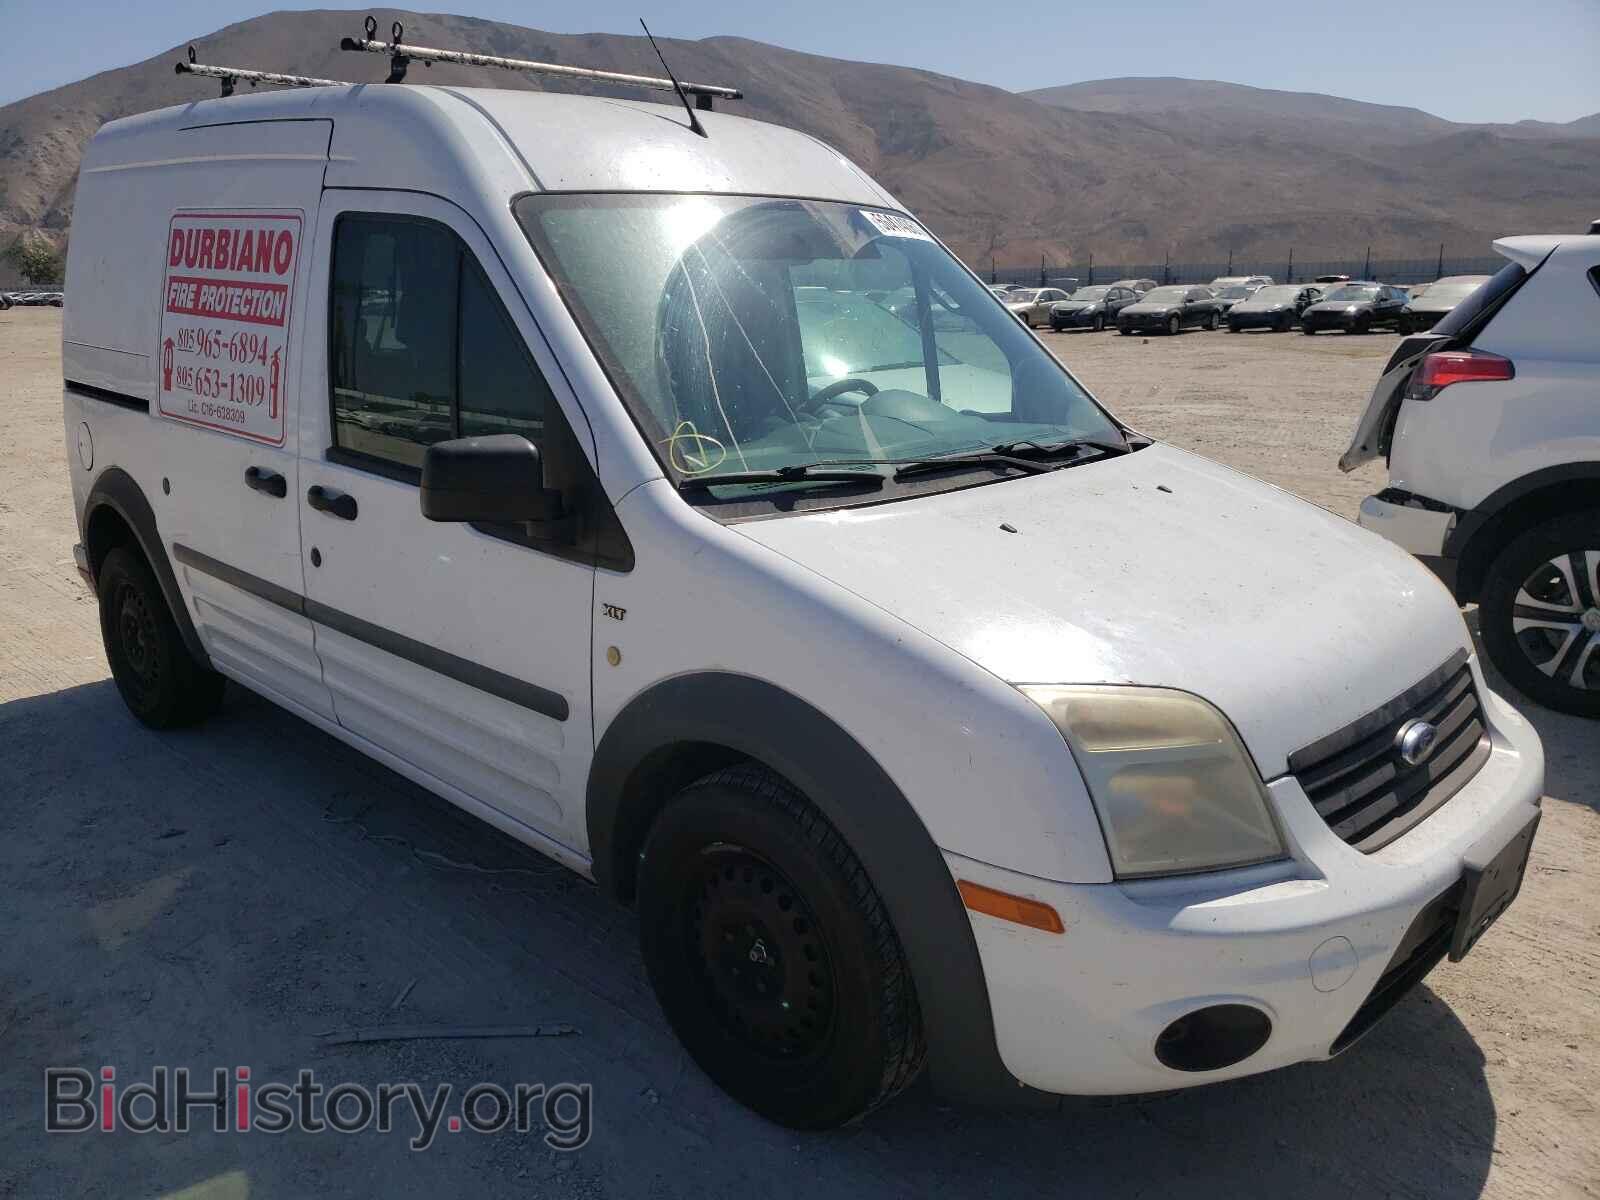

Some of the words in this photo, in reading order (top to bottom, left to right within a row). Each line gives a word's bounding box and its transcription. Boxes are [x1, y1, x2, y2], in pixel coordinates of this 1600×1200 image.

[169, 228, 293, 276] DURBIANO
[168, 282, 197, 309] FIRE
[198, 285, 286, 320] PROTECTION
[177, 327, 195, 349] 805
[195, 327, 268, 366] 965-6894
[176, 366, 193, 387] 805
[195, 367, 265, 407] 653-1309
[602, 603, 626, 621] XLT
